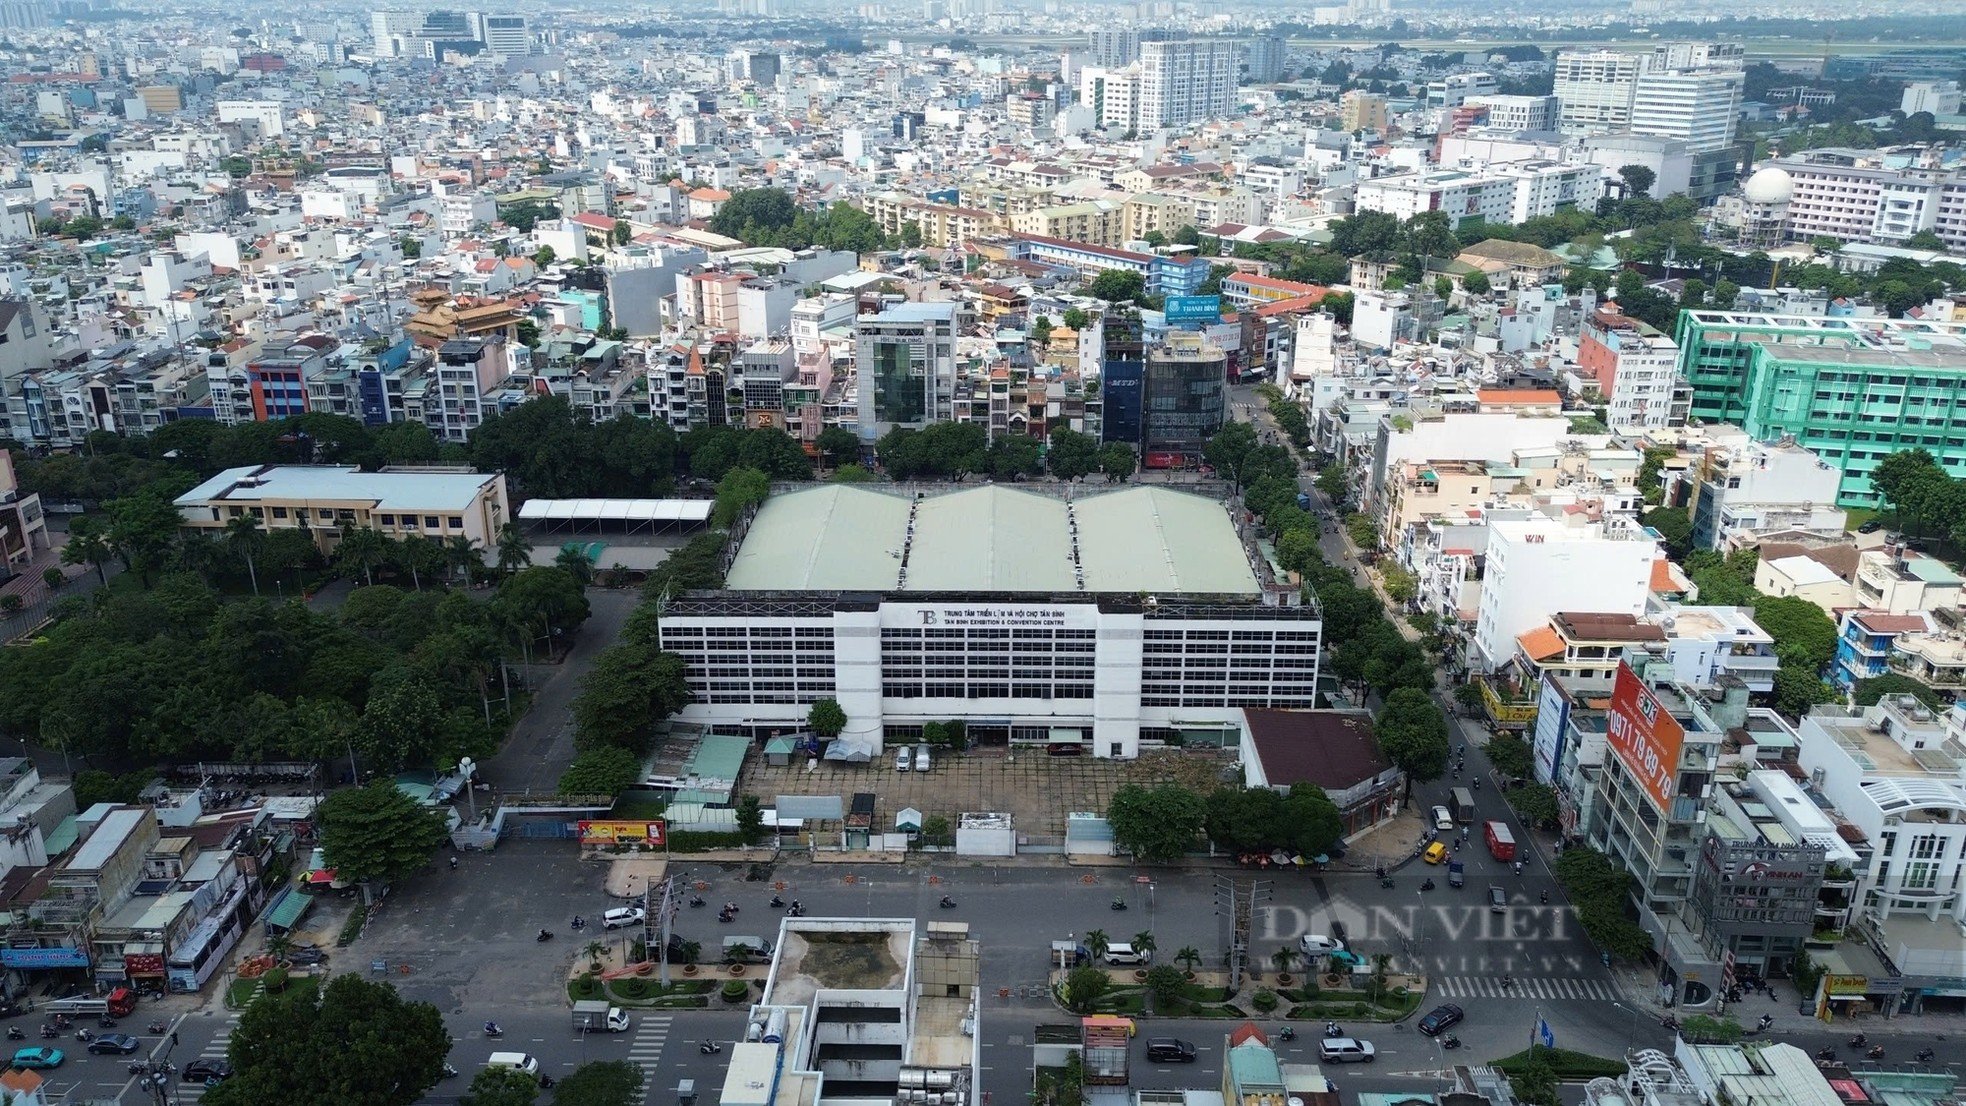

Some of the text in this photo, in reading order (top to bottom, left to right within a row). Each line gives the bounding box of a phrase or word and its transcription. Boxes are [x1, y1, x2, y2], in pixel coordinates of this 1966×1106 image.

[1525, 534, 1544, 543] WIN
[964, 609, 975, 617] TÂM
[1610, 708, 1632, 746] 0971
[1632, 728, 1646, 760] 79
[1644, 746, 1658, 778] 89
[1657, 765, 1672, 800] 79
